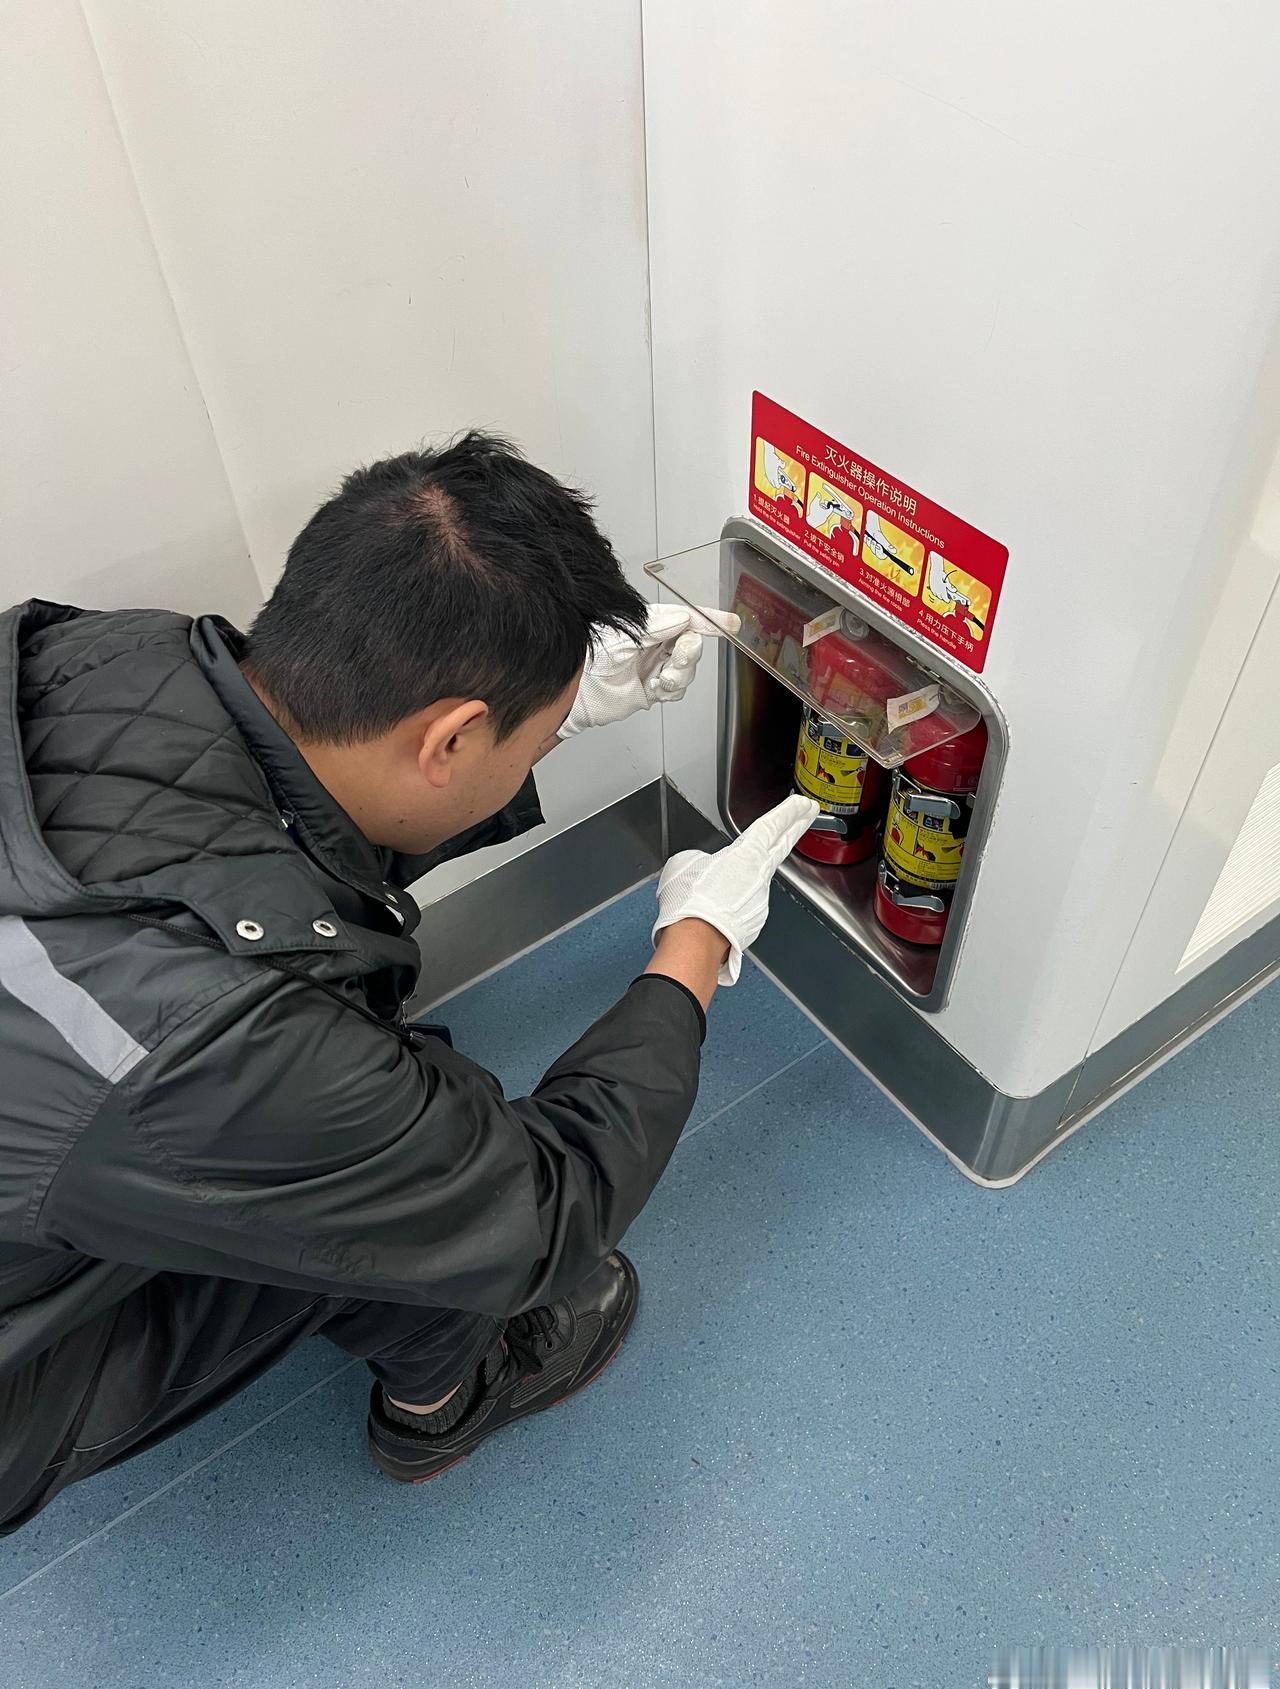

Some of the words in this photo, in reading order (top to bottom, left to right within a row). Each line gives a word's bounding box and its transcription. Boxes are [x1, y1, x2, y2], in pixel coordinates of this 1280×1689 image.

[796, 445, 810, 461] Fire
[811, 456, 858, 491] Extinguisher
[857, 486, 897, 518] Operation
[897, 512, 945, 549] Instructions
[825, 445, 917, 516] 灭火器操作说明
[918, 610, 975, 653] 4.用力压下手柄
